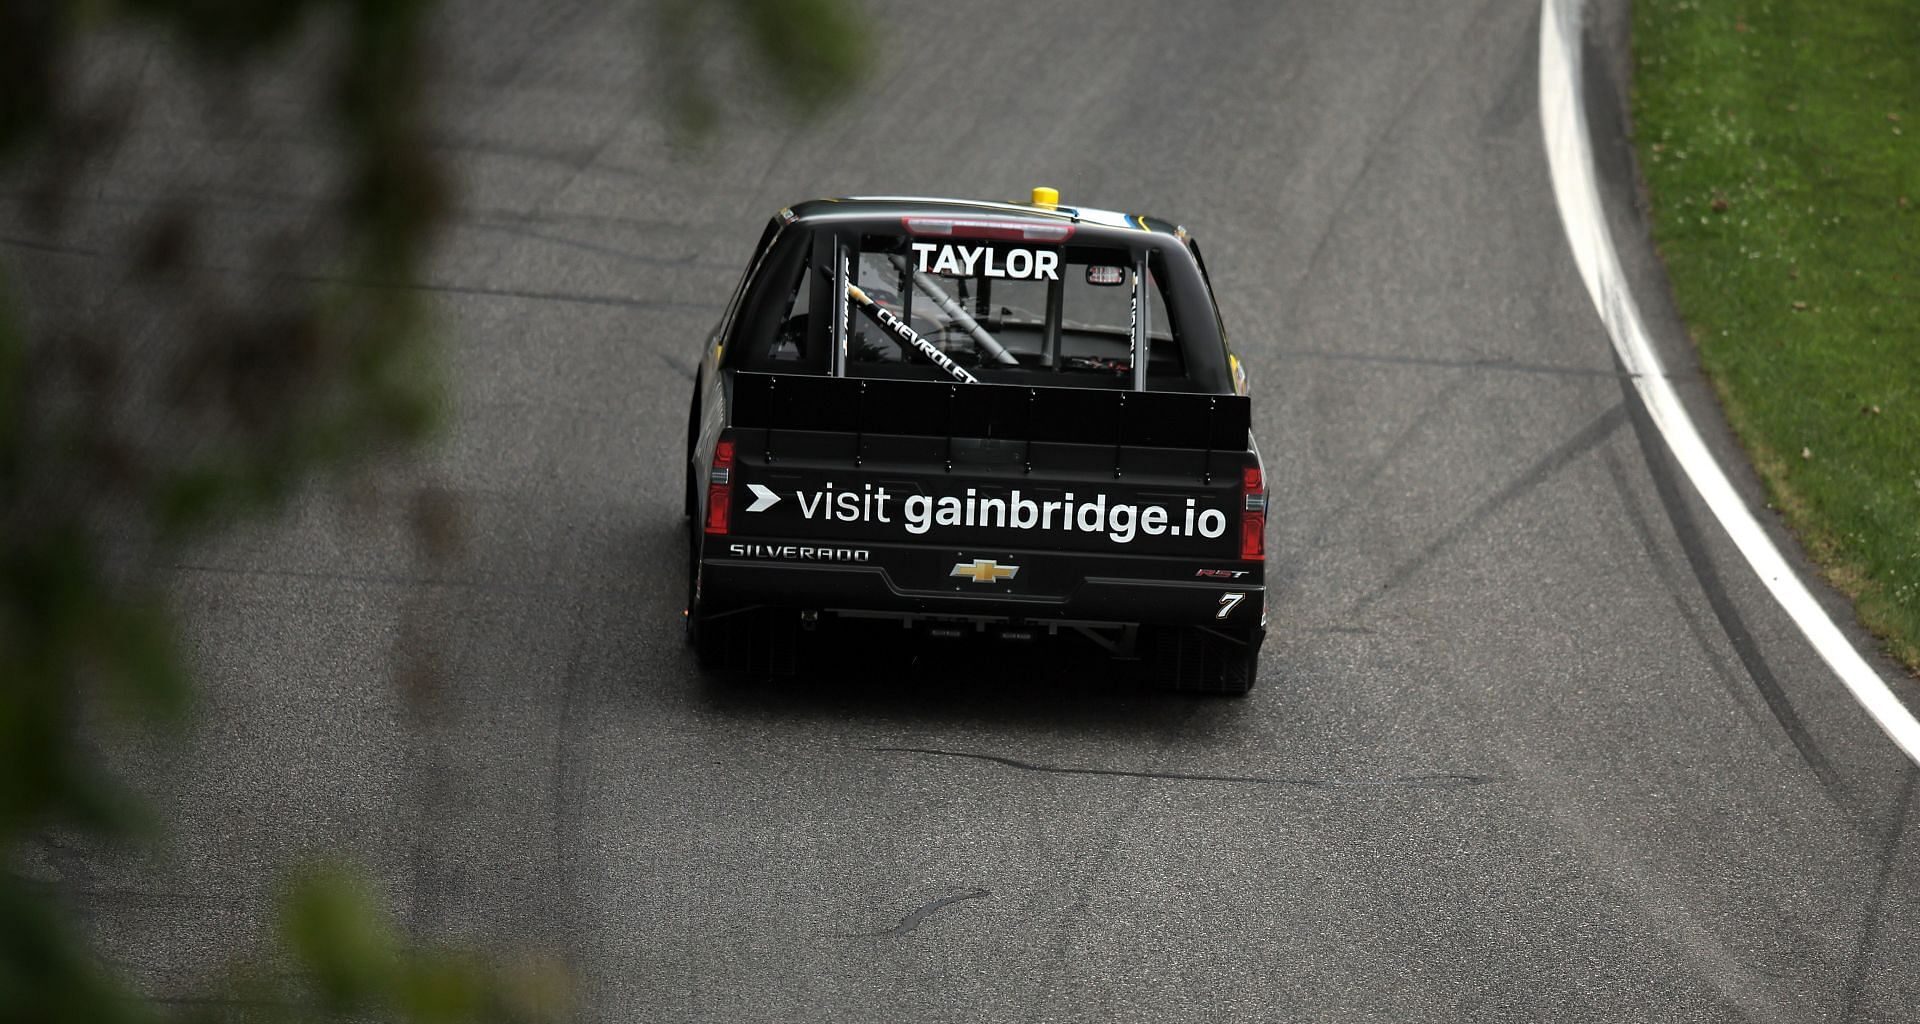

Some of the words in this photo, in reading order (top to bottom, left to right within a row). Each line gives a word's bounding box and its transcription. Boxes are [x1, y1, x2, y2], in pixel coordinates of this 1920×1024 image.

[911, 242, 1059, 280] TAYLOR
[877, 308, 978, 384] CHEVROLET
[796, 482, 891, 523] visit
[904, 488, 1227, 544] gainbridge.io
[730, 544, 869, 561] SILVERADO
[1195, 568, 1250, 578] RST
[1216, 592, 1246, 619] 7
